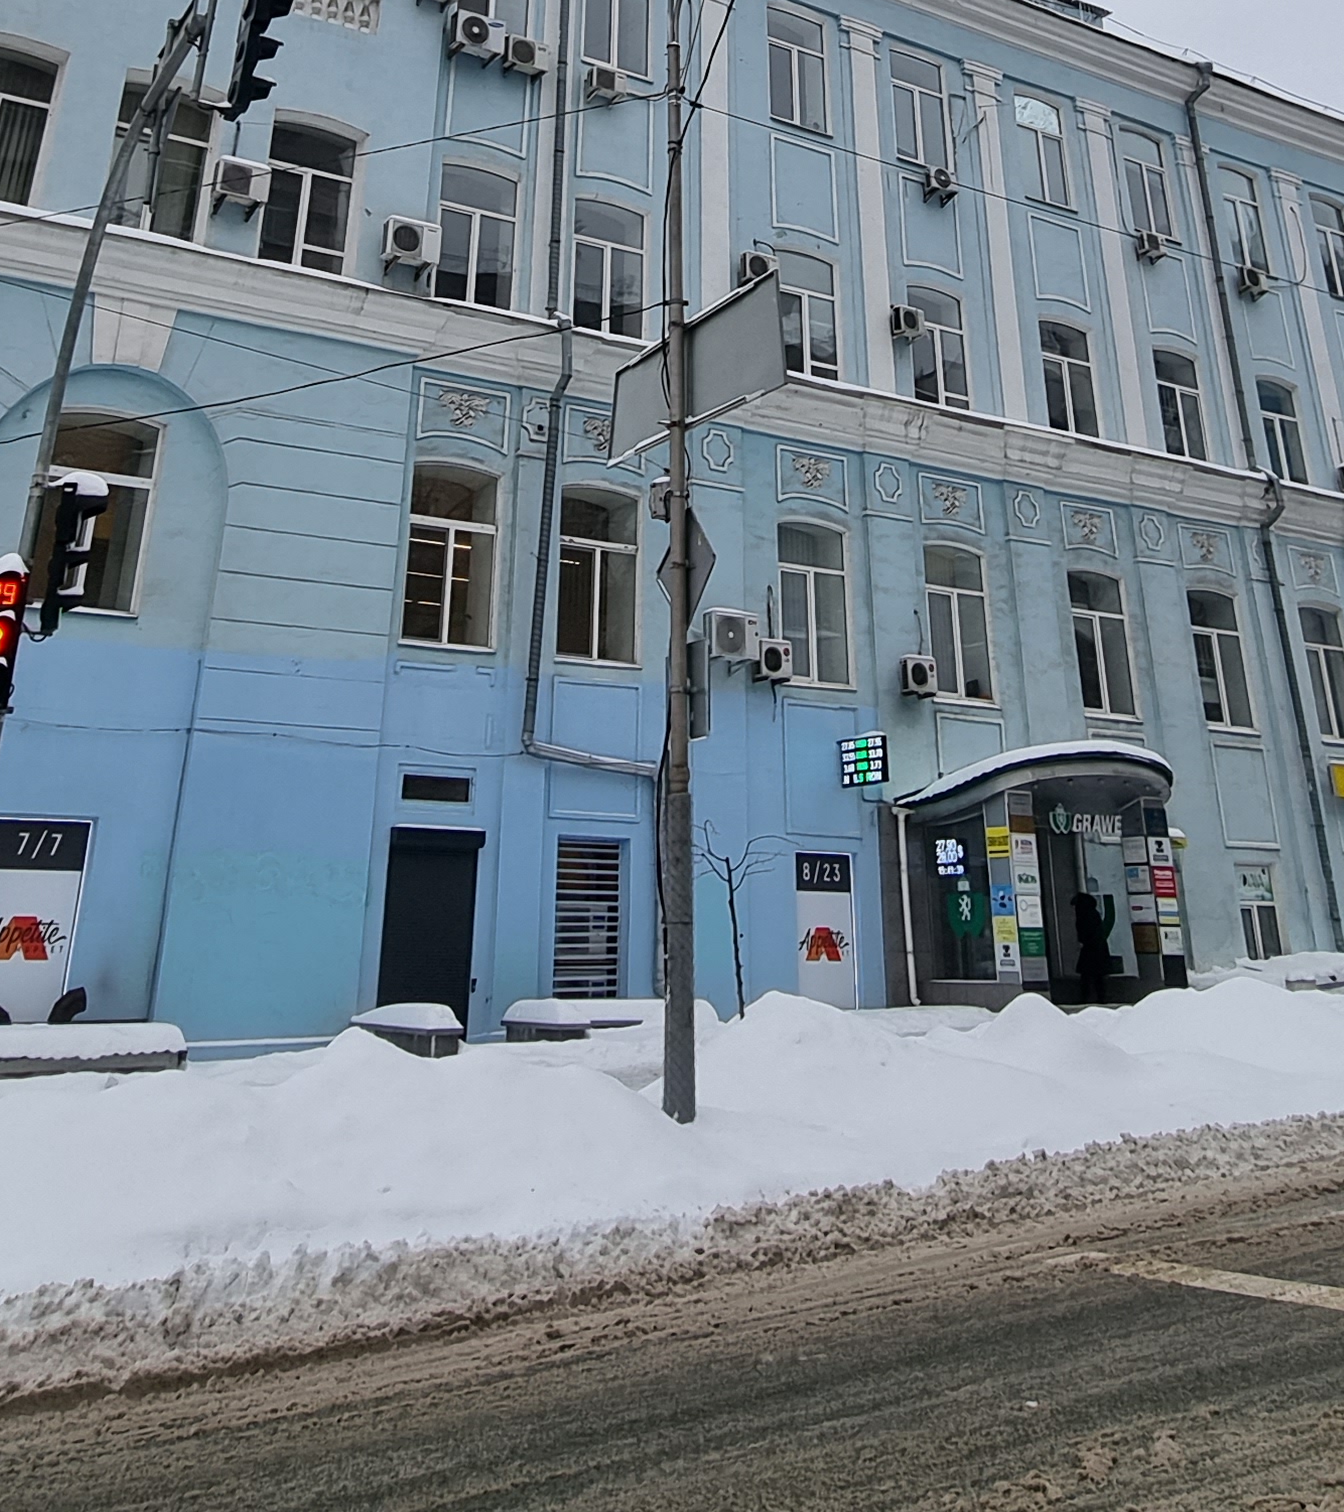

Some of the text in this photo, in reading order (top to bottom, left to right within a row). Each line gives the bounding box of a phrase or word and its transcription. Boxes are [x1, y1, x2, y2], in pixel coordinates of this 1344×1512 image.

[1072, 813, 1123, 834] GRAWE
[16, 829, 63, 859] 7/7
[802, 860, 841, 884] 8/23
